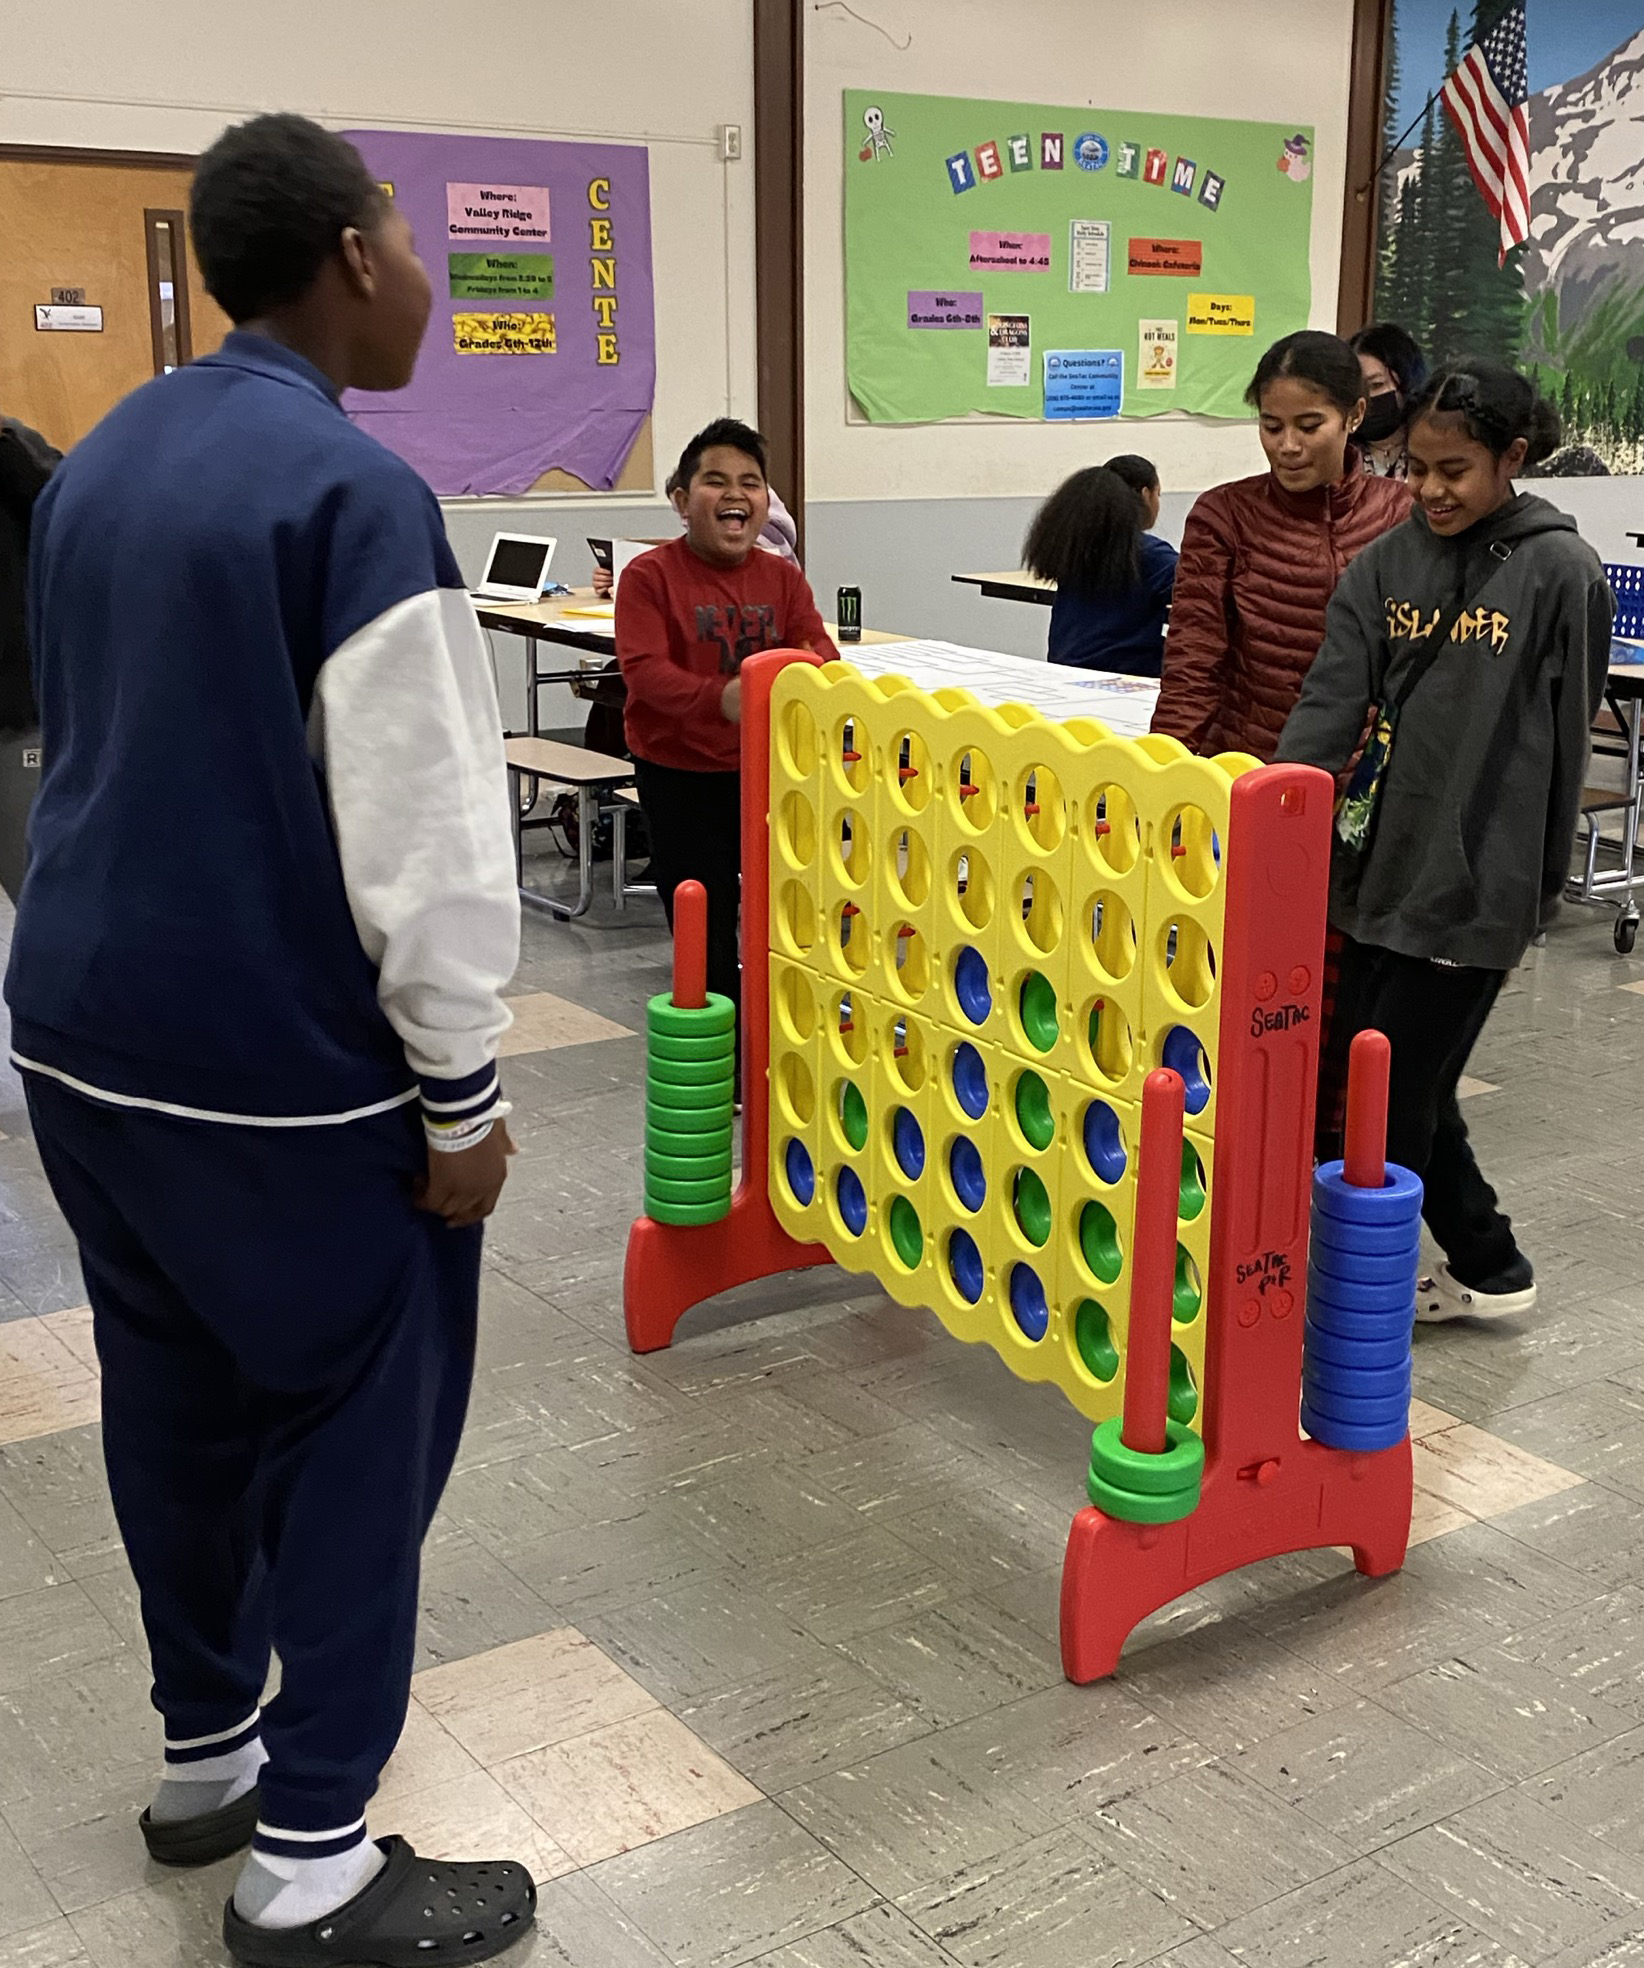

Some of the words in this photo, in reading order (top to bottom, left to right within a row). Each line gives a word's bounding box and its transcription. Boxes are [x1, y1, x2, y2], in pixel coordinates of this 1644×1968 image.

[948, 135, 1063, 187] TEEN
[1121, 146, 1222, 204] TIME
[480, 190, 517, 202] Where:
[465, 207, 500, 220] Valley
[502, 208, 533, 221] Ridge
[449, 224, 510, 238] Community
[512, 226, 548, 238] Center
[486, 258, 518, 269] When:
[587, 178, 620, 366] CENTE
[58, 290, 79, 304] 402
[1210, 302, 1232, 313] Days:
[911, 313, 944, 323] Grades
[493, 320, 521, 331] Who:
[459, 338, 502, 349] Grades
[1063, 358, 1105, 368] Questions?
[1385, 597, 1509, 655] ISLDER
